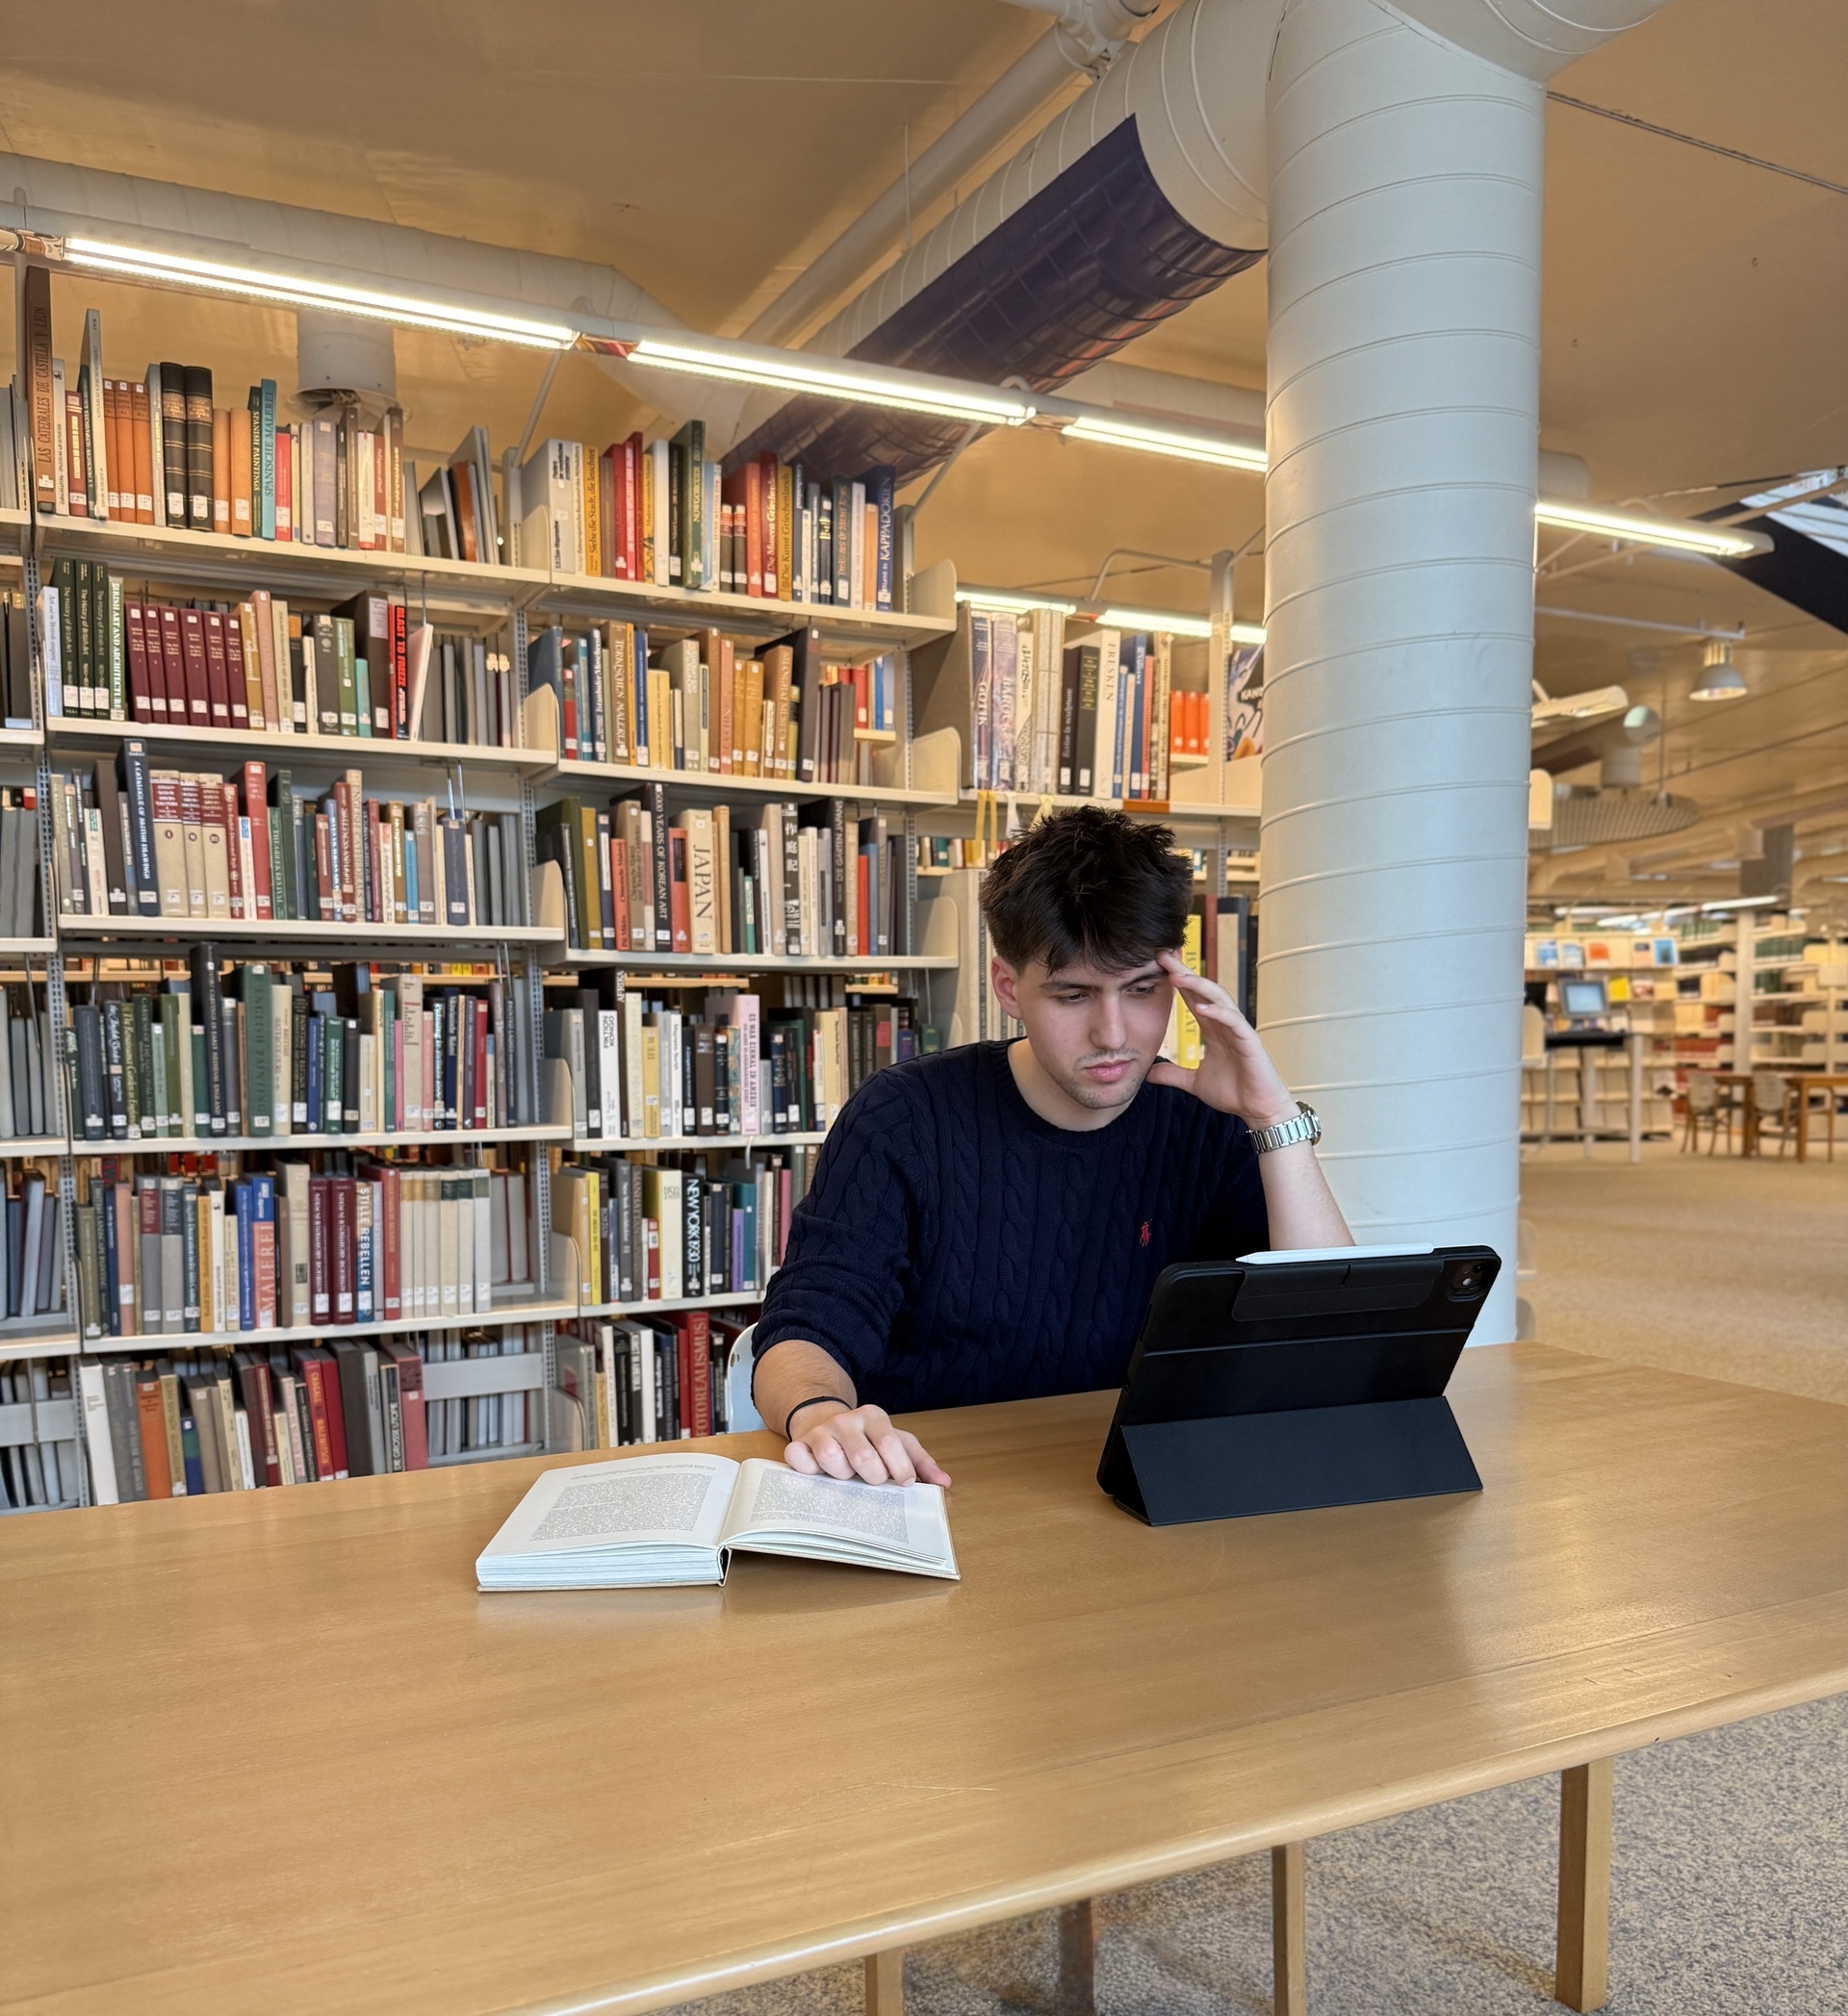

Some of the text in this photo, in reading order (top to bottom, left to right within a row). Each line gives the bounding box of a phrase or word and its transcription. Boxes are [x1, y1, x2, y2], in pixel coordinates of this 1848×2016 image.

[35, 343, 49, 378] CASTILLA
[37, 382, 49, 394] DE
[37, 397, 50, 444] CATEDRALES
[38, 447, 51, 463] LAS
[265, 392, 274, 498] SPANISCHE MALEREI
[252, 447, 261, 492] PAINTINGS
[781, 472, 790, 579] Die Kunst Griechenlands
[879, 473, 890, 558] KAPPADOKIEN
[588, 532, 597, 554] Siehe
[766, 523, 776, 555] Museen
[766, 556, 775, 572] Die
[64, 598, 72, 618] History
[80, 600, 89, 620] History
[113, 610, 121, 627] ART
[397, 606, 405, 639] BLAST
[113, 627, 121, 646] AND
[397, 641, 405, 653] TO
[113, 646, 122, 709] ARCHITECTURE
[398, 655, 406, 687] FREEZE
[780, 651, 789, 702] SHANGHAI
[1107, 643, 1116, 702] FRESKEN
[595, 675, 603, 712] Istanbuler
[978, 681, 988, 726] GOTIK
[1001, 676, 1013, 732] BAROCK
[1064, 688, 1073, 725] sculpture
[135, 767, 143, 804] CATALOGUE
[137, 806, 144, 816] OF
[834, 801, 843, 831] JAPANS
[139, 817, 147, 843] BRITISH
[352, 784, 362, 899] ENGLISH CATHEDRALS
[141, 844, 150, 880] DRAWINGS
[655, 791, 668, 920] 5000 YEARS OF KOREAN ART
[693, 845, 712, 920] JAPAN
[616, 970, 625, 1003] AFRIKA
[123, 1012, 134, 1025] The
[124, 1026, 136, 1065] Renaissance
[254, 988, 267, 1113] ENGLISH PAINTING
[126, 1065, 138, 1091] Garden
[95, 1214, 105, 1255] LANDSCAPE
[360, 1187, 371, 1286] STILLE REBELLEN
[687, 1179, 700, 1263] NEW YORK 1930
[260, 1225, 275, 1312] MALEREI
[311, 1371, 321, 1404] CHAGALL
[689, 1321, 709, 1437] FOTOREALISMUS
[390, 1402, 401, 1470] DIE GROSSE UTOPIE
